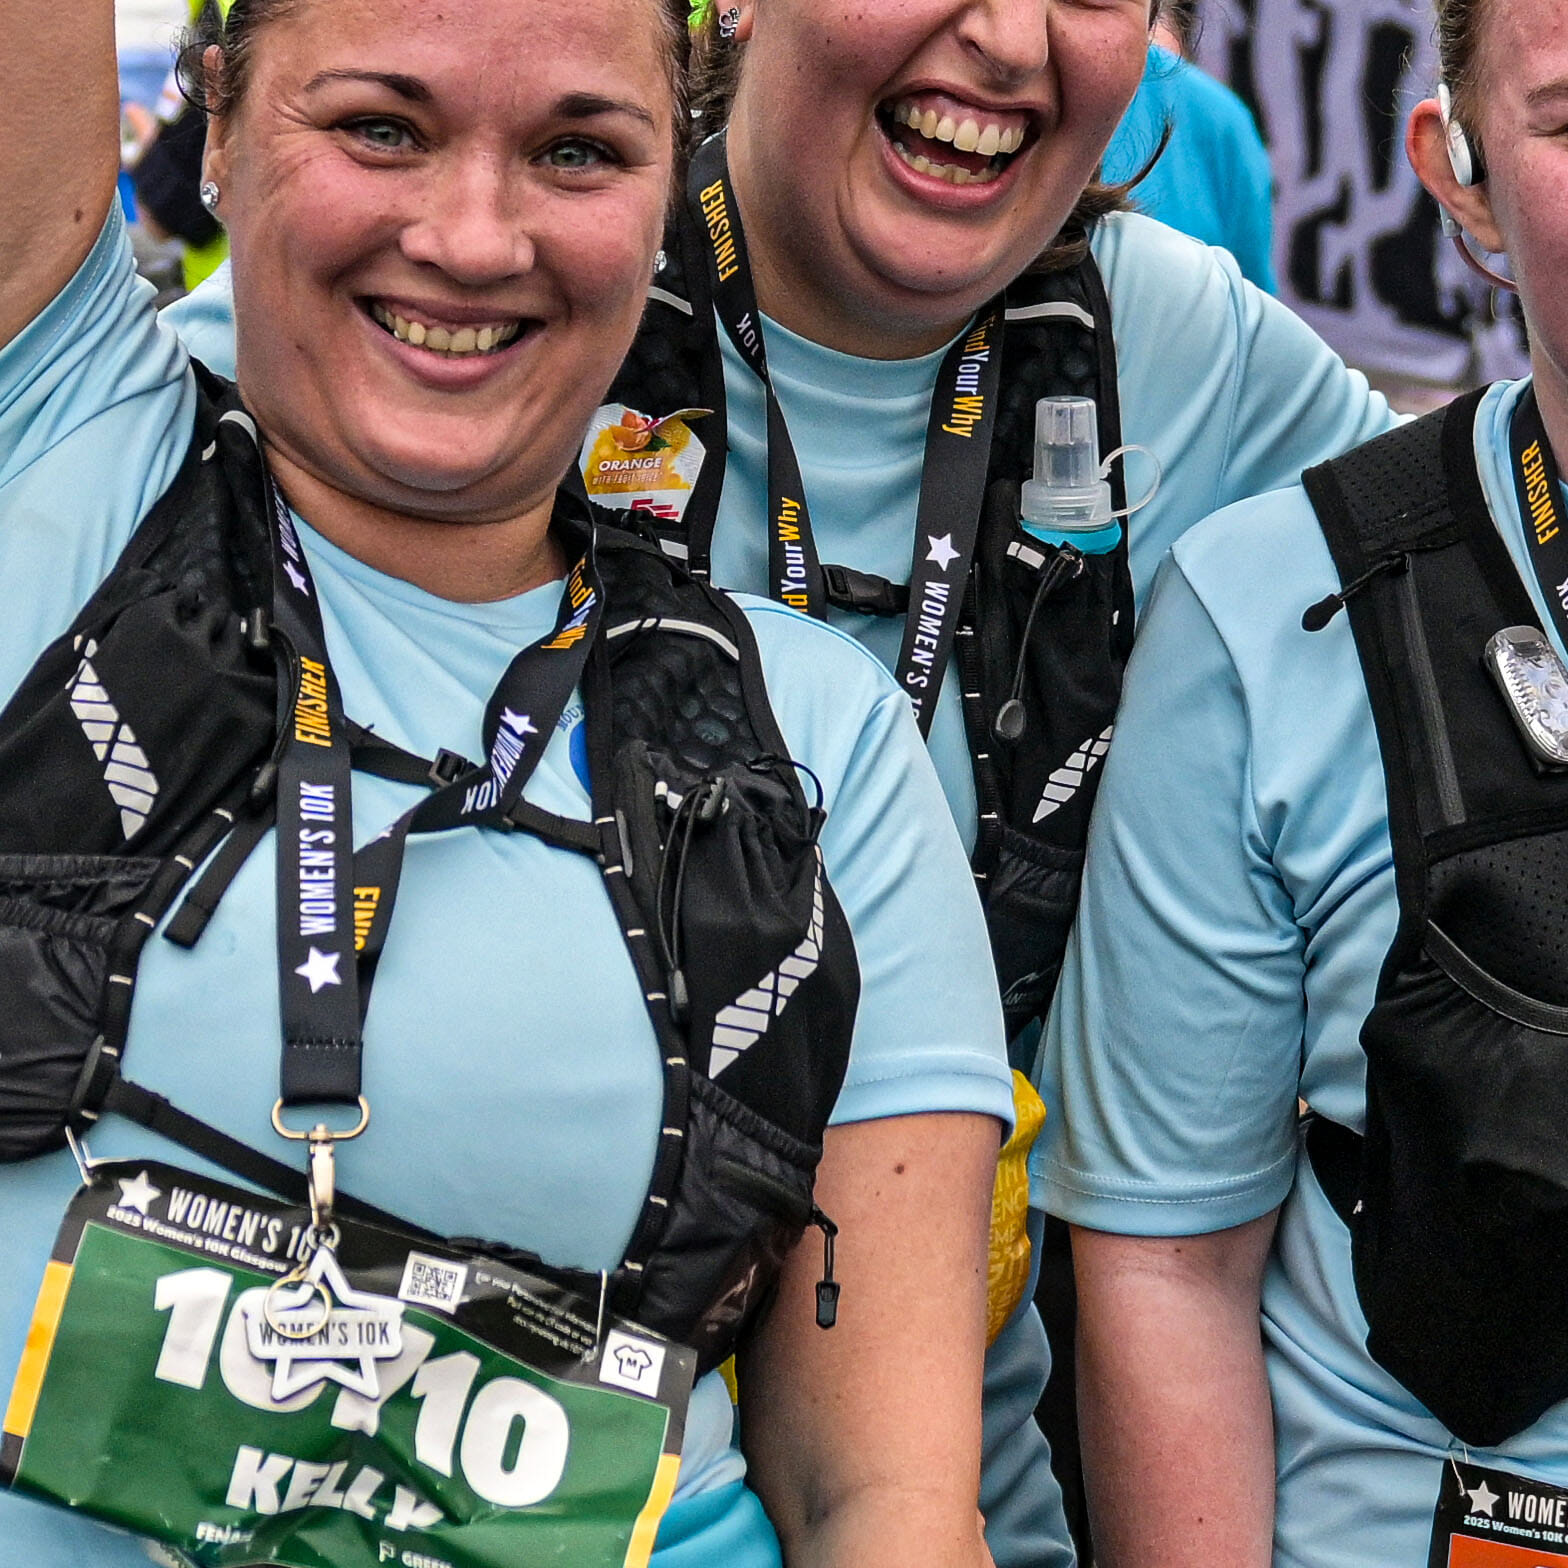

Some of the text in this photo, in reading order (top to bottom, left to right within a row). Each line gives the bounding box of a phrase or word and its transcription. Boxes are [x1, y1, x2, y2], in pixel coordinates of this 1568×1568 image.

[699, 179, 739, 282] FINISHER
[736, 312, 759, 355] 10K
[599, 457, 662, 472] ORANGE
[1520, 439, 1560, 545] FINISHER
[906, 579, 950, 688] WOMEN'S
[294, 655, 333, 748] FINISHER
[298, 781, 337, 936] WOMEN'S 10K
[106, 1204, 289, 1273] 2025 Women's 10K Glasgow
[167, 1186, 312, 1264] WOMEN'S 10
[259, 1320, 390, 1347] WOMEN'S 10K
[626, 1357, 638, 1368] M
[225, 1444, 444, 1531] KELLY
[1463, 1514, 1491, 1530] 2025
[1492, 1520, 1541, 1540] Women's
[1542, 1530, 1563, 1544] 10K
